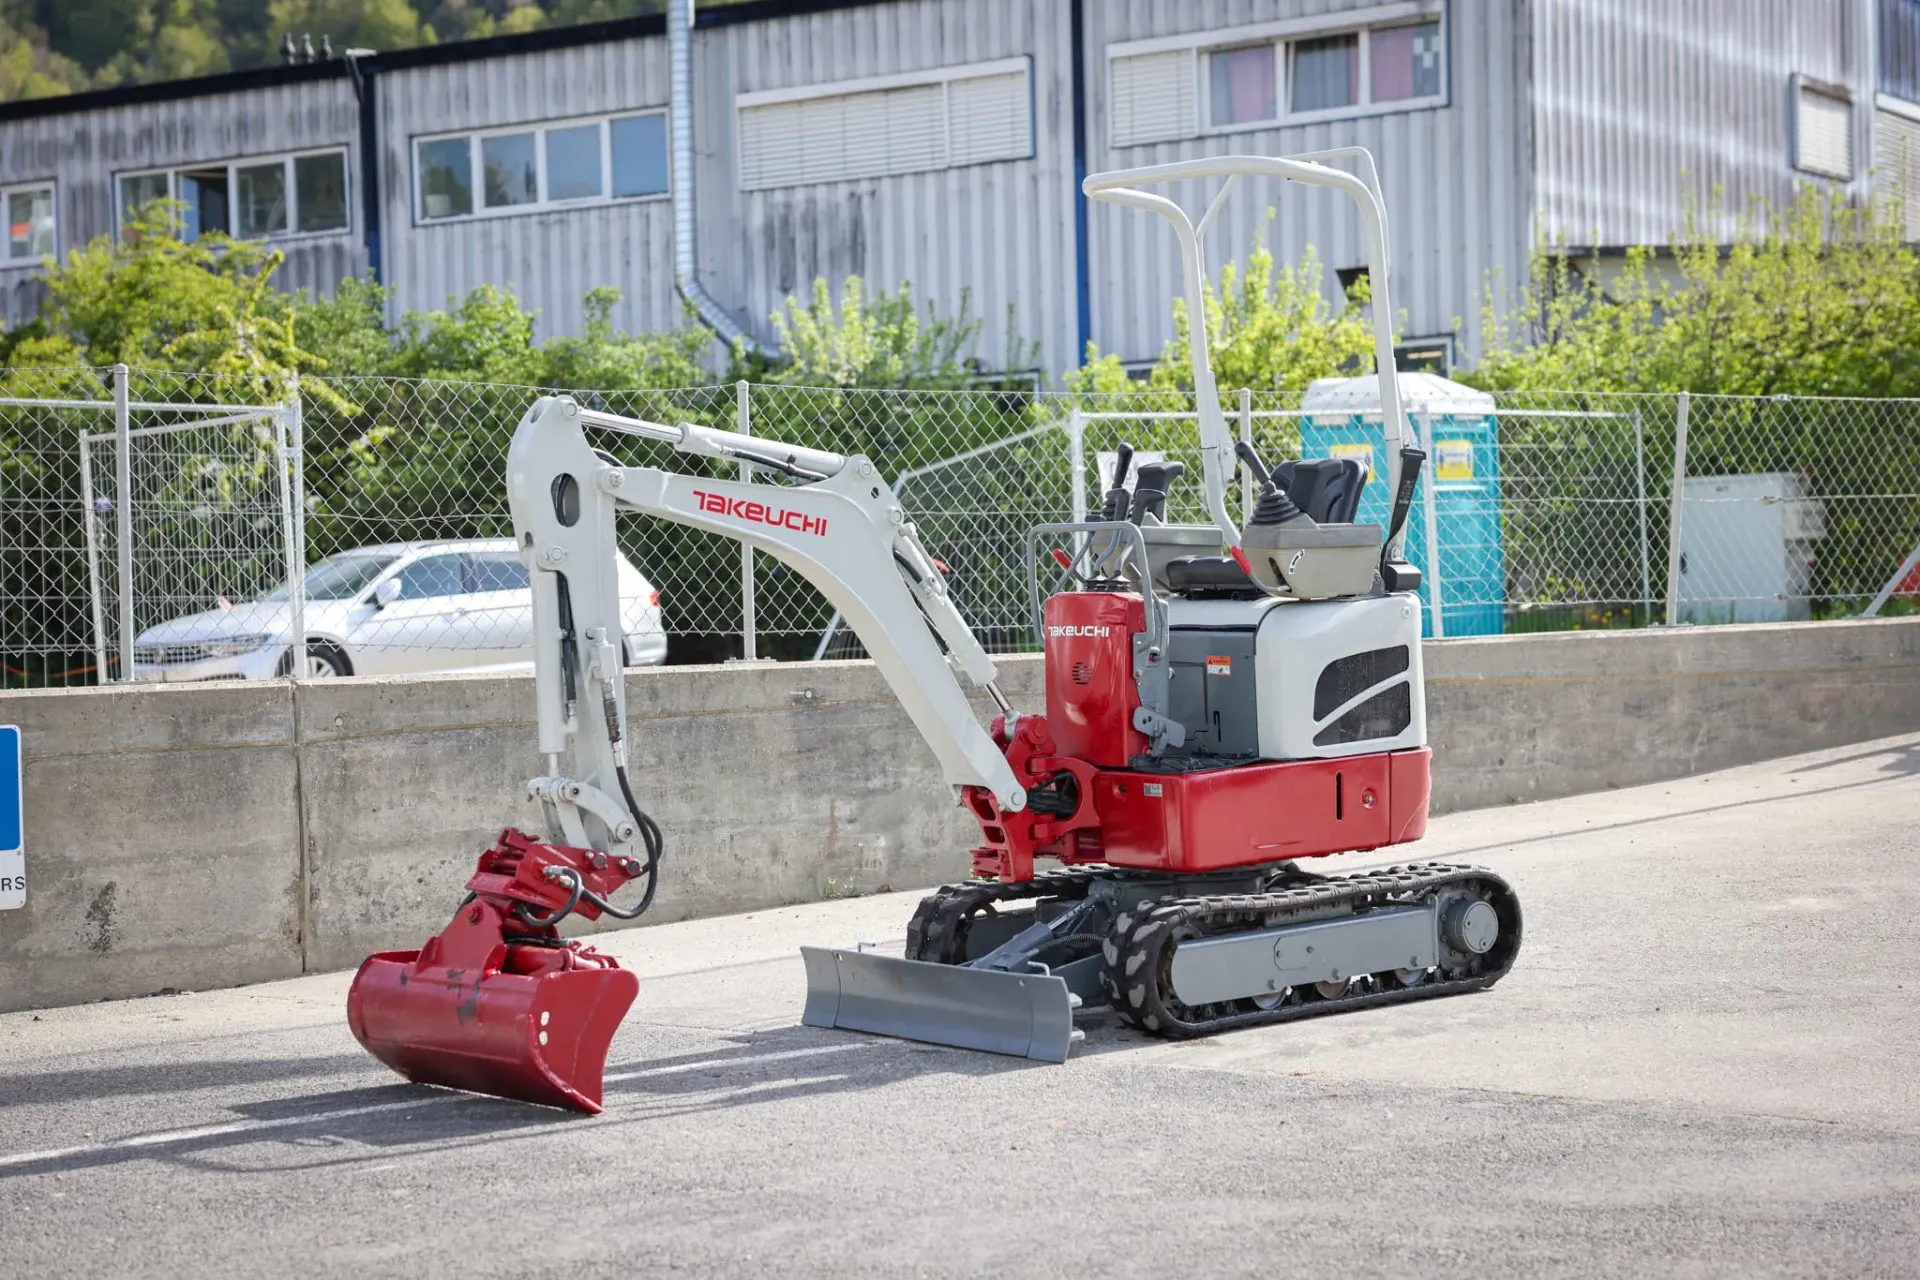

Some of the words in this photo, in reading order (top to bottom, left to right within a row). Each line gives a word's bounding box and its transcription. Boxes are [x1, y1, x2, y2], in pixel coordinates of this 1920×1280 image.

[693, 490, 827, 536] TAKEUCHI
[1048, 625, 1110, 637] TAKEUCHI
[1, 876, 25, 891] RS
